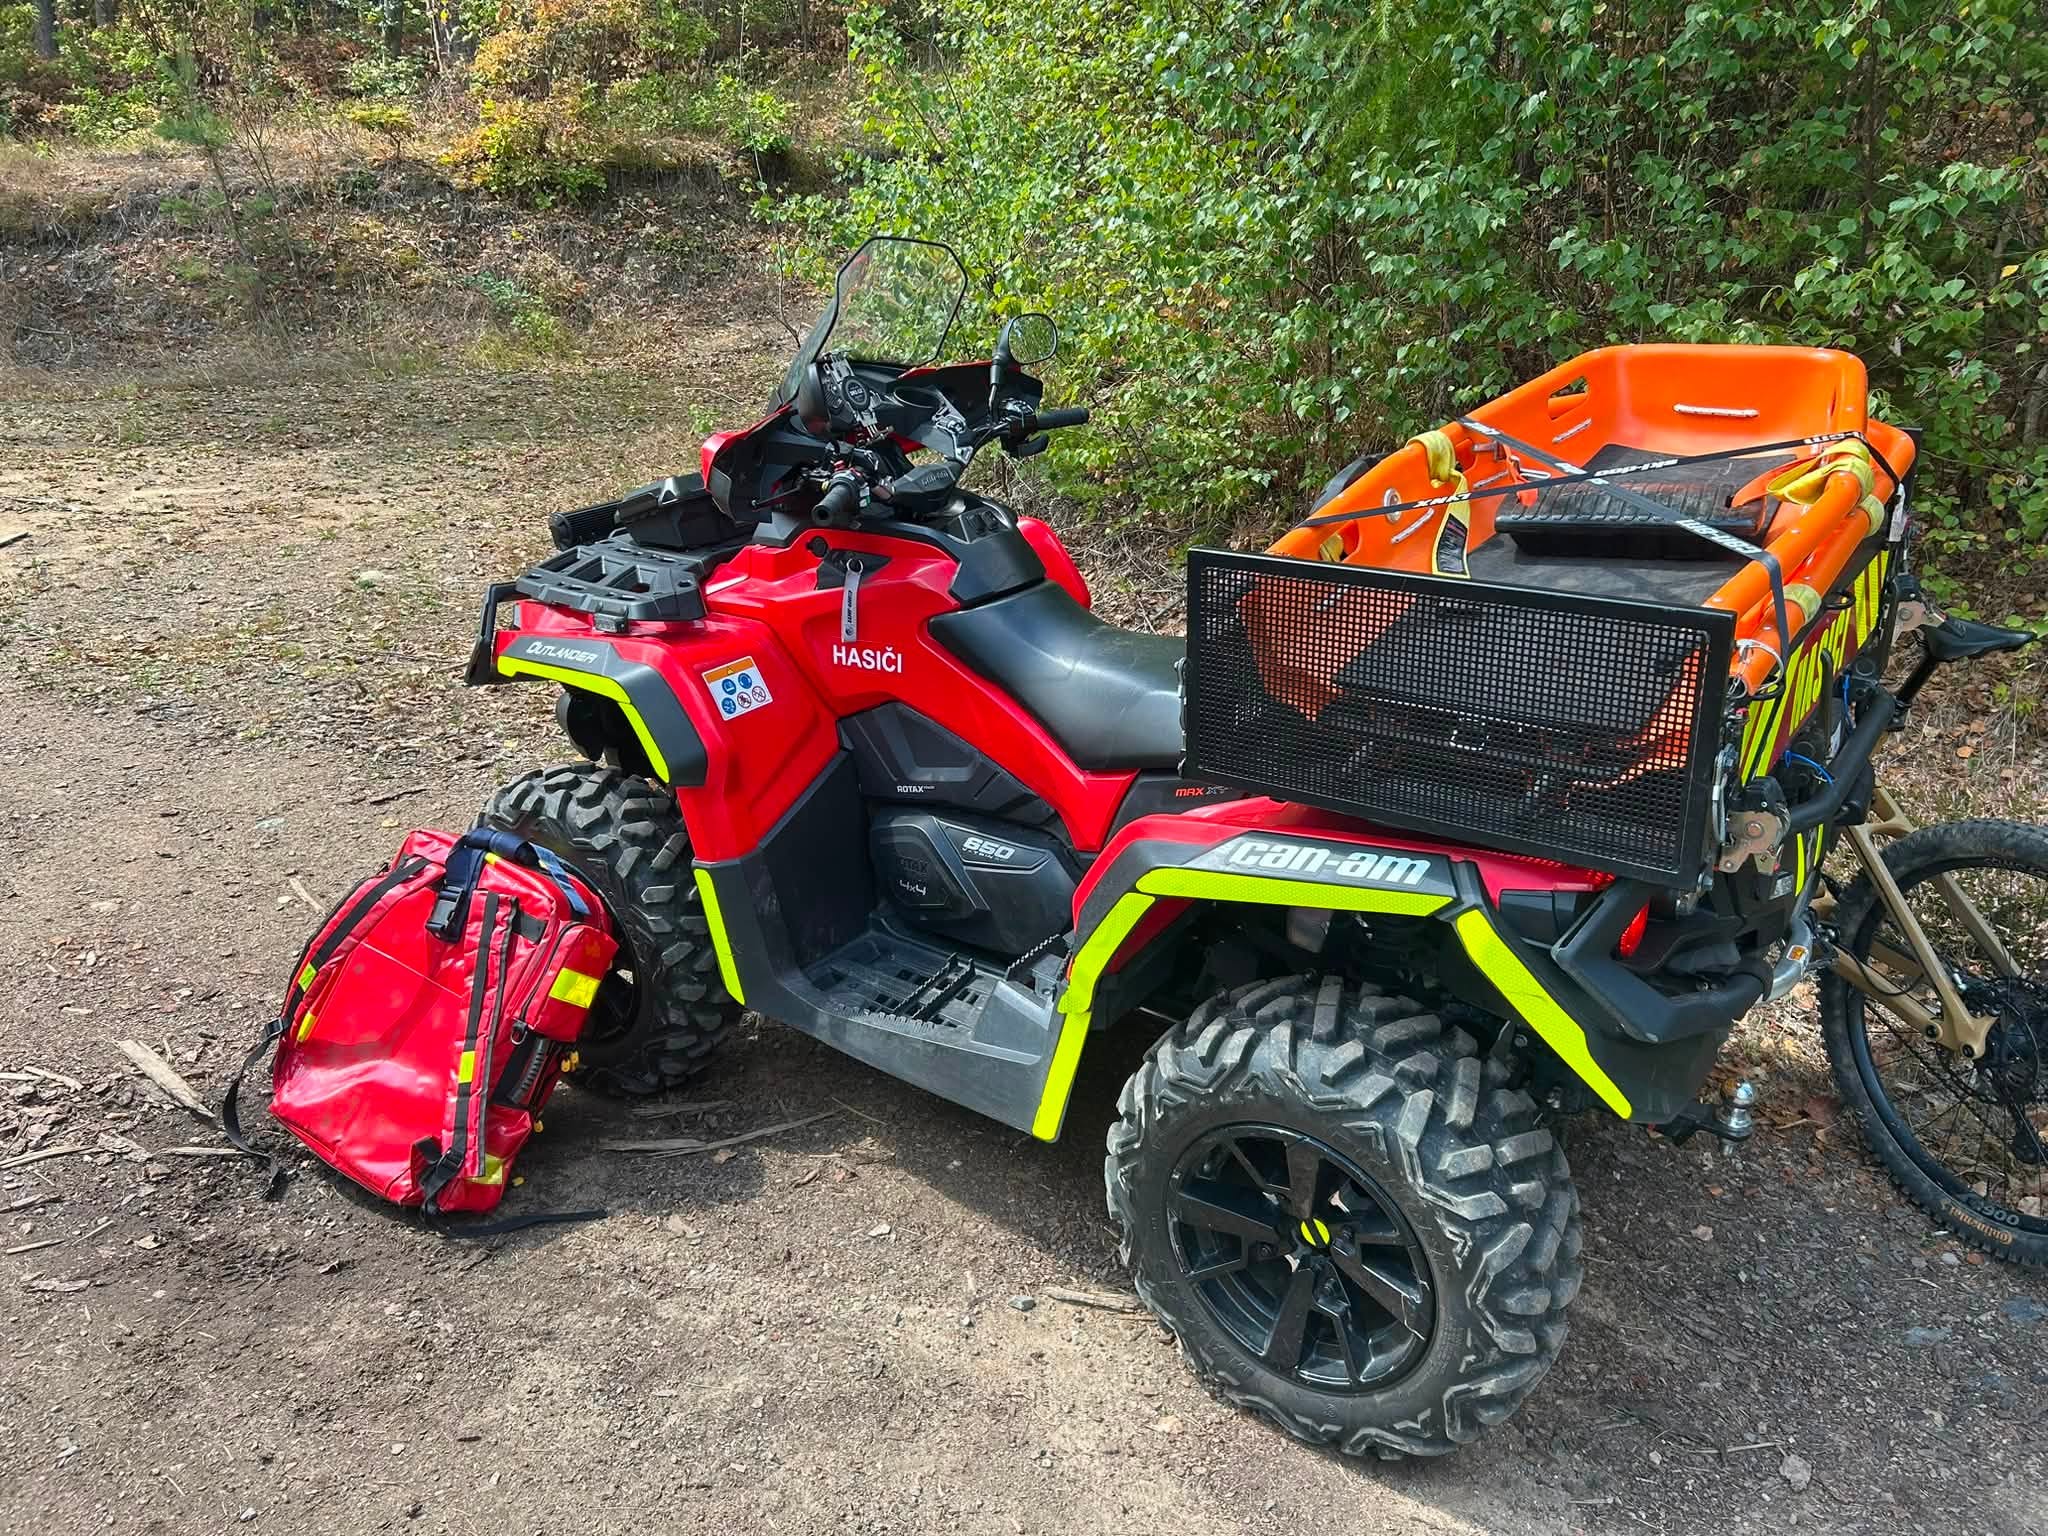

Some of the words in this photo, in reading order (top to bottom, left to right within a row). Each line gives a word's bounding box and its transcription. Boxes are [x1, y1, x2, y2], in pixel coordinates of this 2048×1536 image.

[1413, 492, 1473, 508] LYNX
[1675, 519, 1763, 555] can-am
[526, 641, 599, 664] OUTLANDER
[833, 644, 902, 673] HASIČI
[897, 785, 924, 793] ROTAX
[1175, 787, 1205, 798] MAX
[1229, 841, 1431, 885] can-am
[899, 879, 927, 896] 4x4
